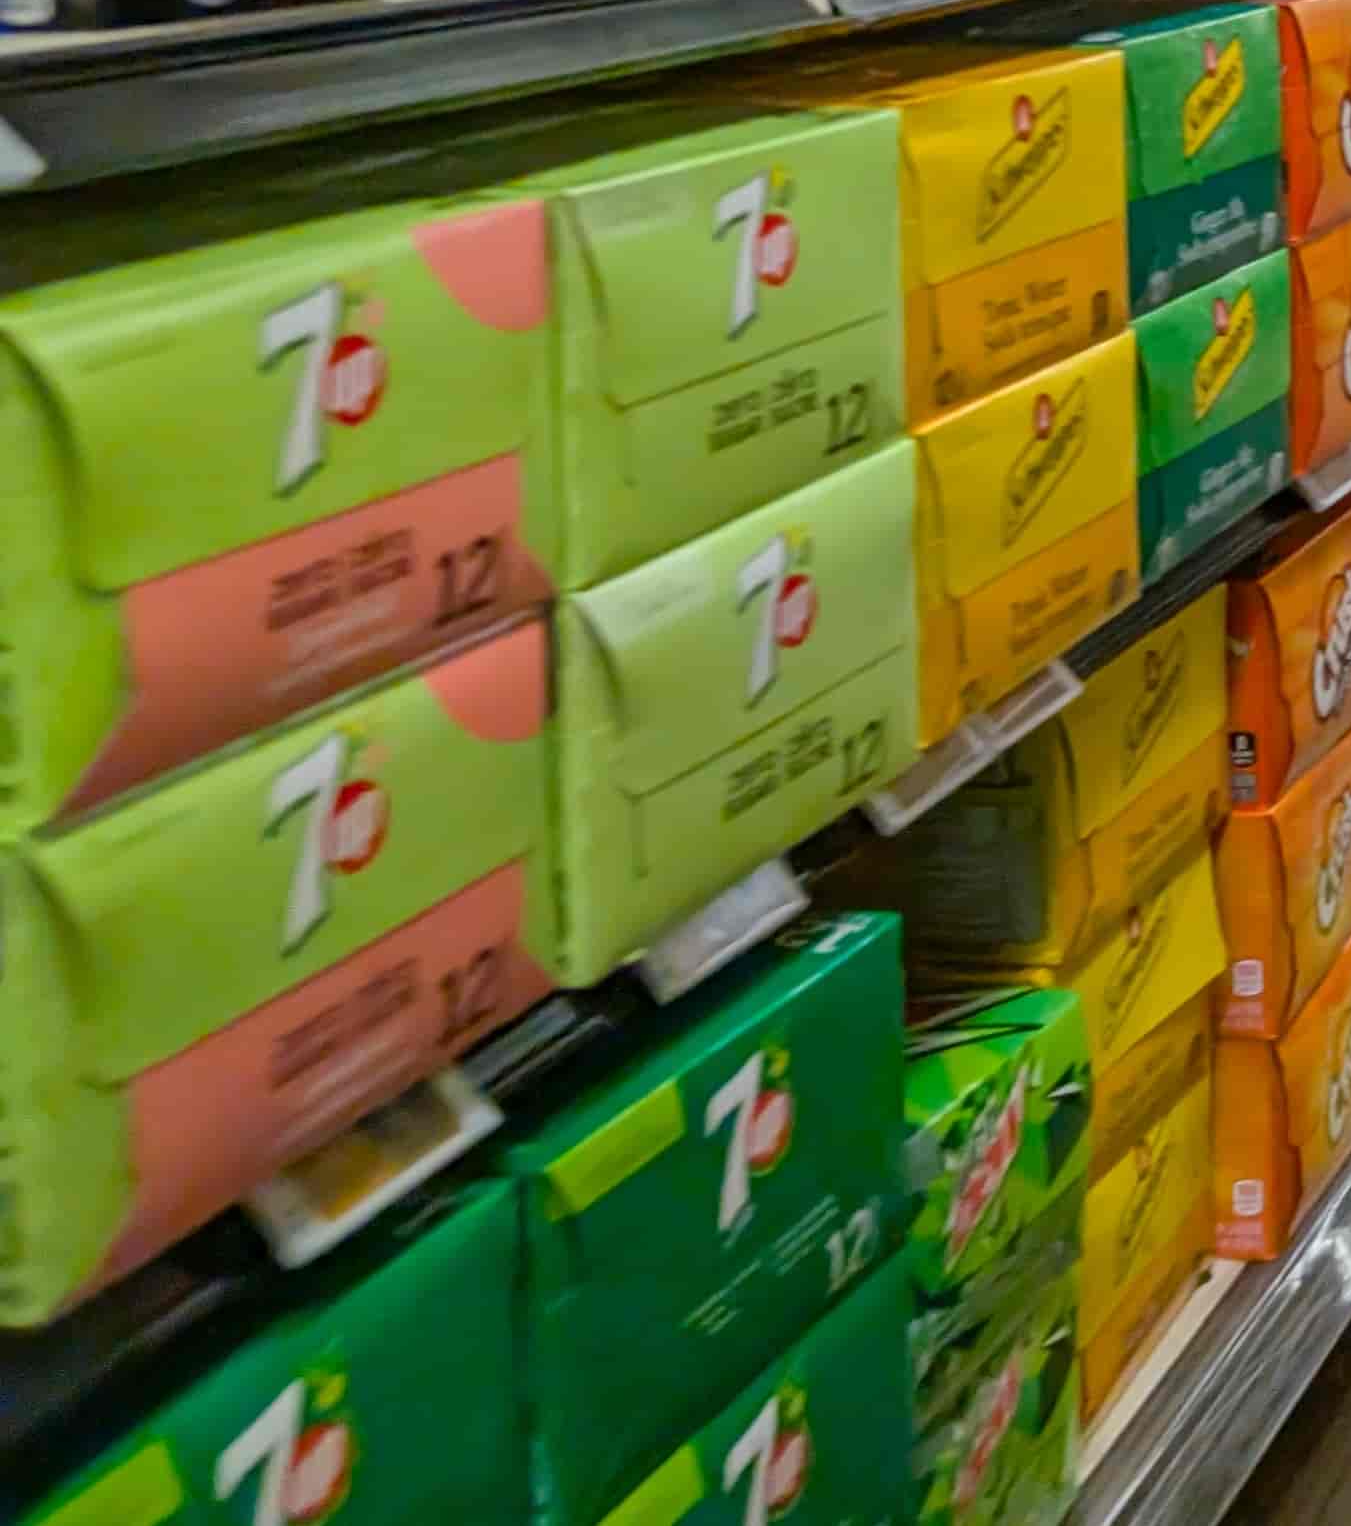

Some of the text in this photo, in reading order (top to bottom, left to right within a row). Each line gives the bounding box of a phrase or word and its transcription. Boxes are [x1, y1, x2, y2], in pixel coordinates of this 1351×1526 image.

[824, 383, 869, 456] 12
[433, 529, 507, 630] 12
[836, 717, 887, 798] 12
[436, 945, 508, 1047] 12
[826, 1196, 878, 1294] 12
